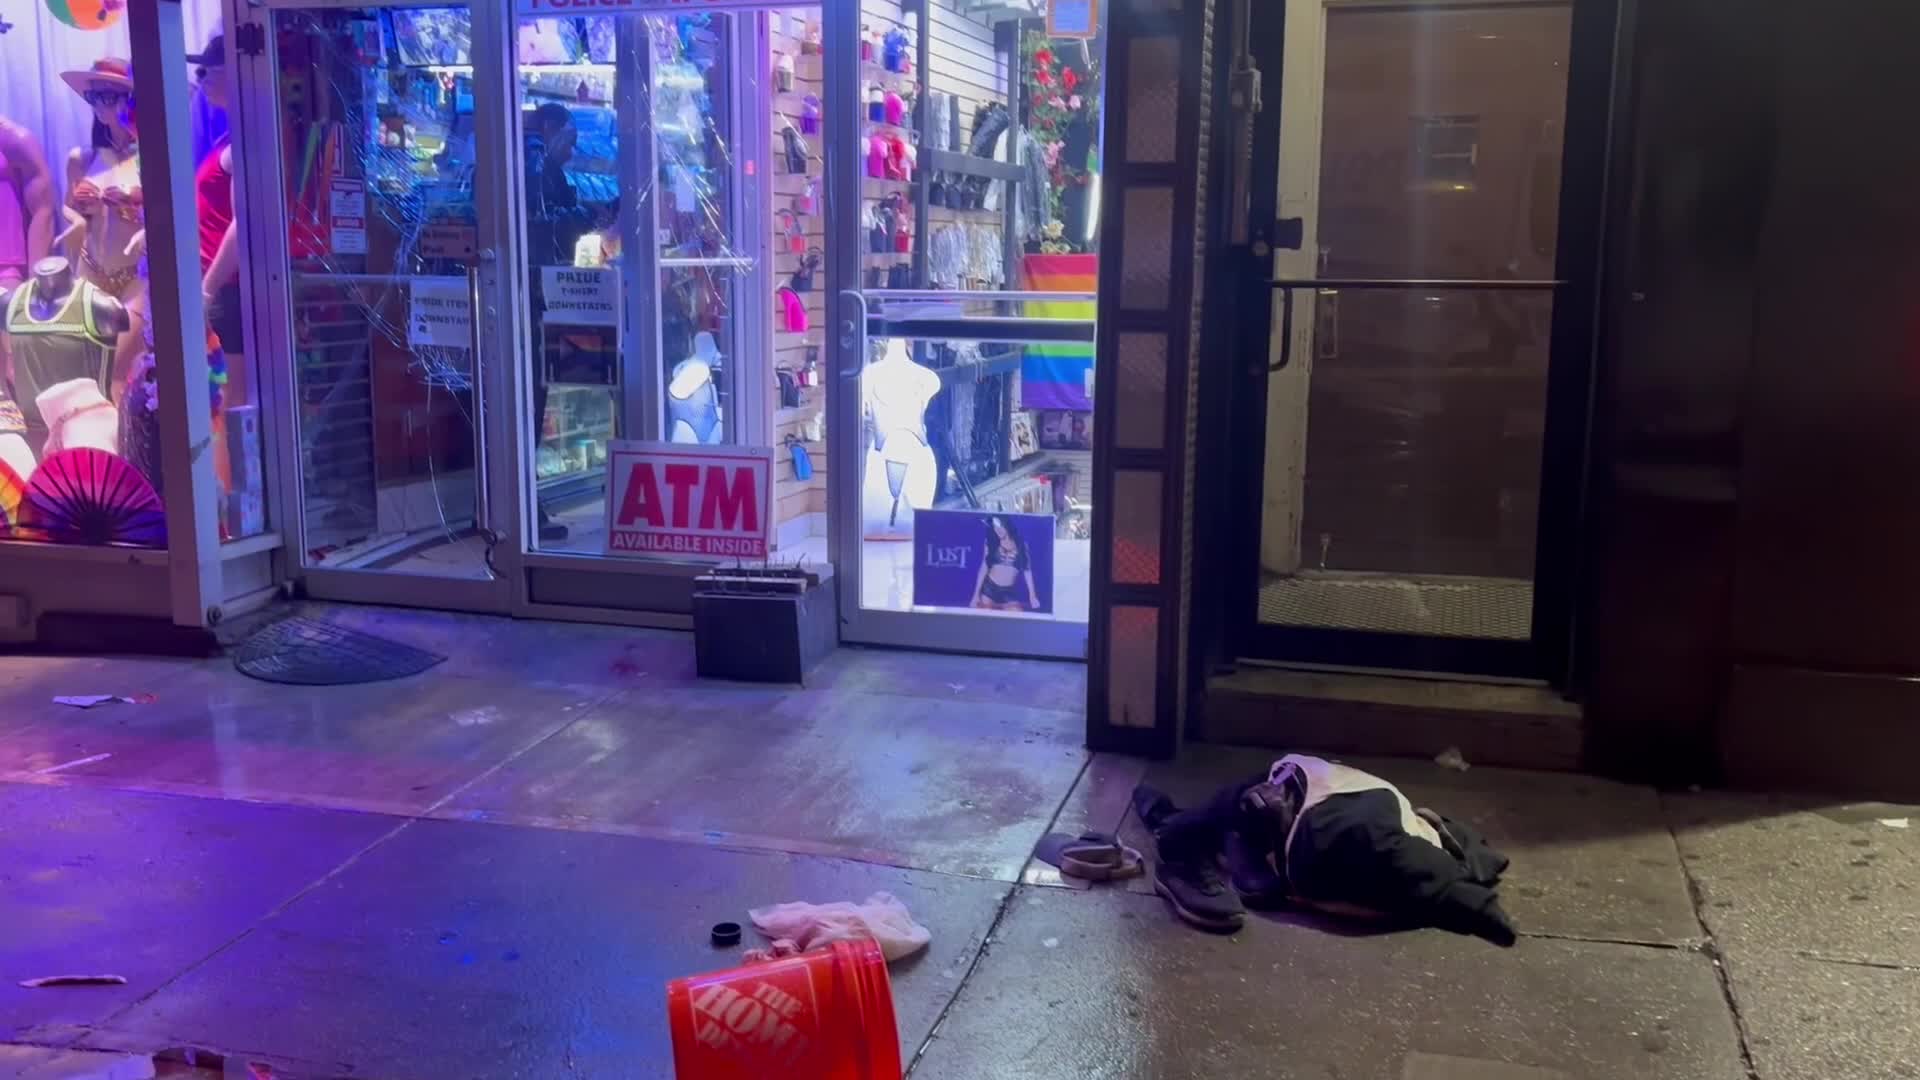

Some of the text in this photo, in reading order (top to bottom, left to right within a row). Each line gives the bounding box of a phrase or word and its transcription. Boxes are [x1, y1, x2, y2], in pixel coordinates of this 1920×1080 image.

[556, 271, 601, 284] PRIDE
[561, 287, 599, 296] T-SHIRT
[547, 301, 613, 312] DOWNSTAIRS
[616, 462, 759, 532] ATM
[612, 531, 762, 555] AVAILABLE INSIDE
